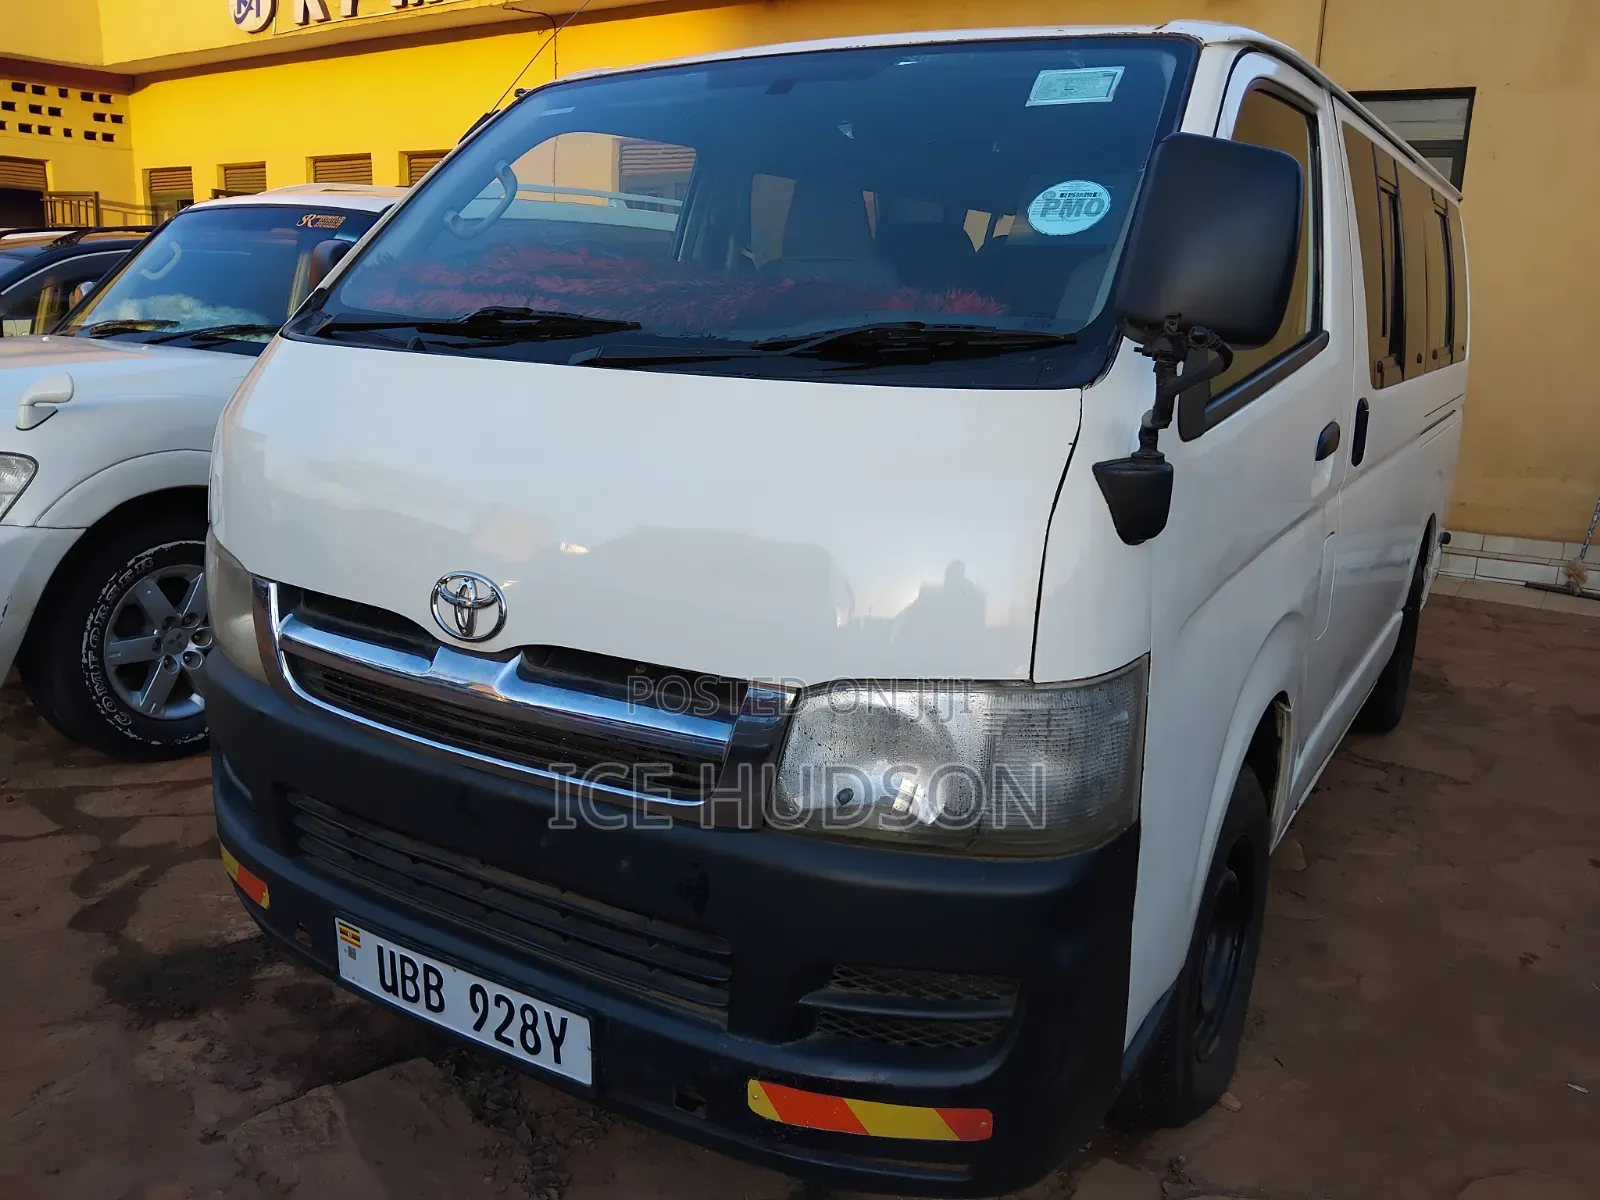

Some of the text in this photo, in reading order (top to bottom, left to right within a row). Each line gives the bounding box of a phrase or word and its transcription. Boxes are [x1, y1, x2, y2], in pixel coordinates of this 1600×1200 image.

[1039, 197, 1105, 217] PMO
[376, 943, 569, 1066] UBB 928Y
